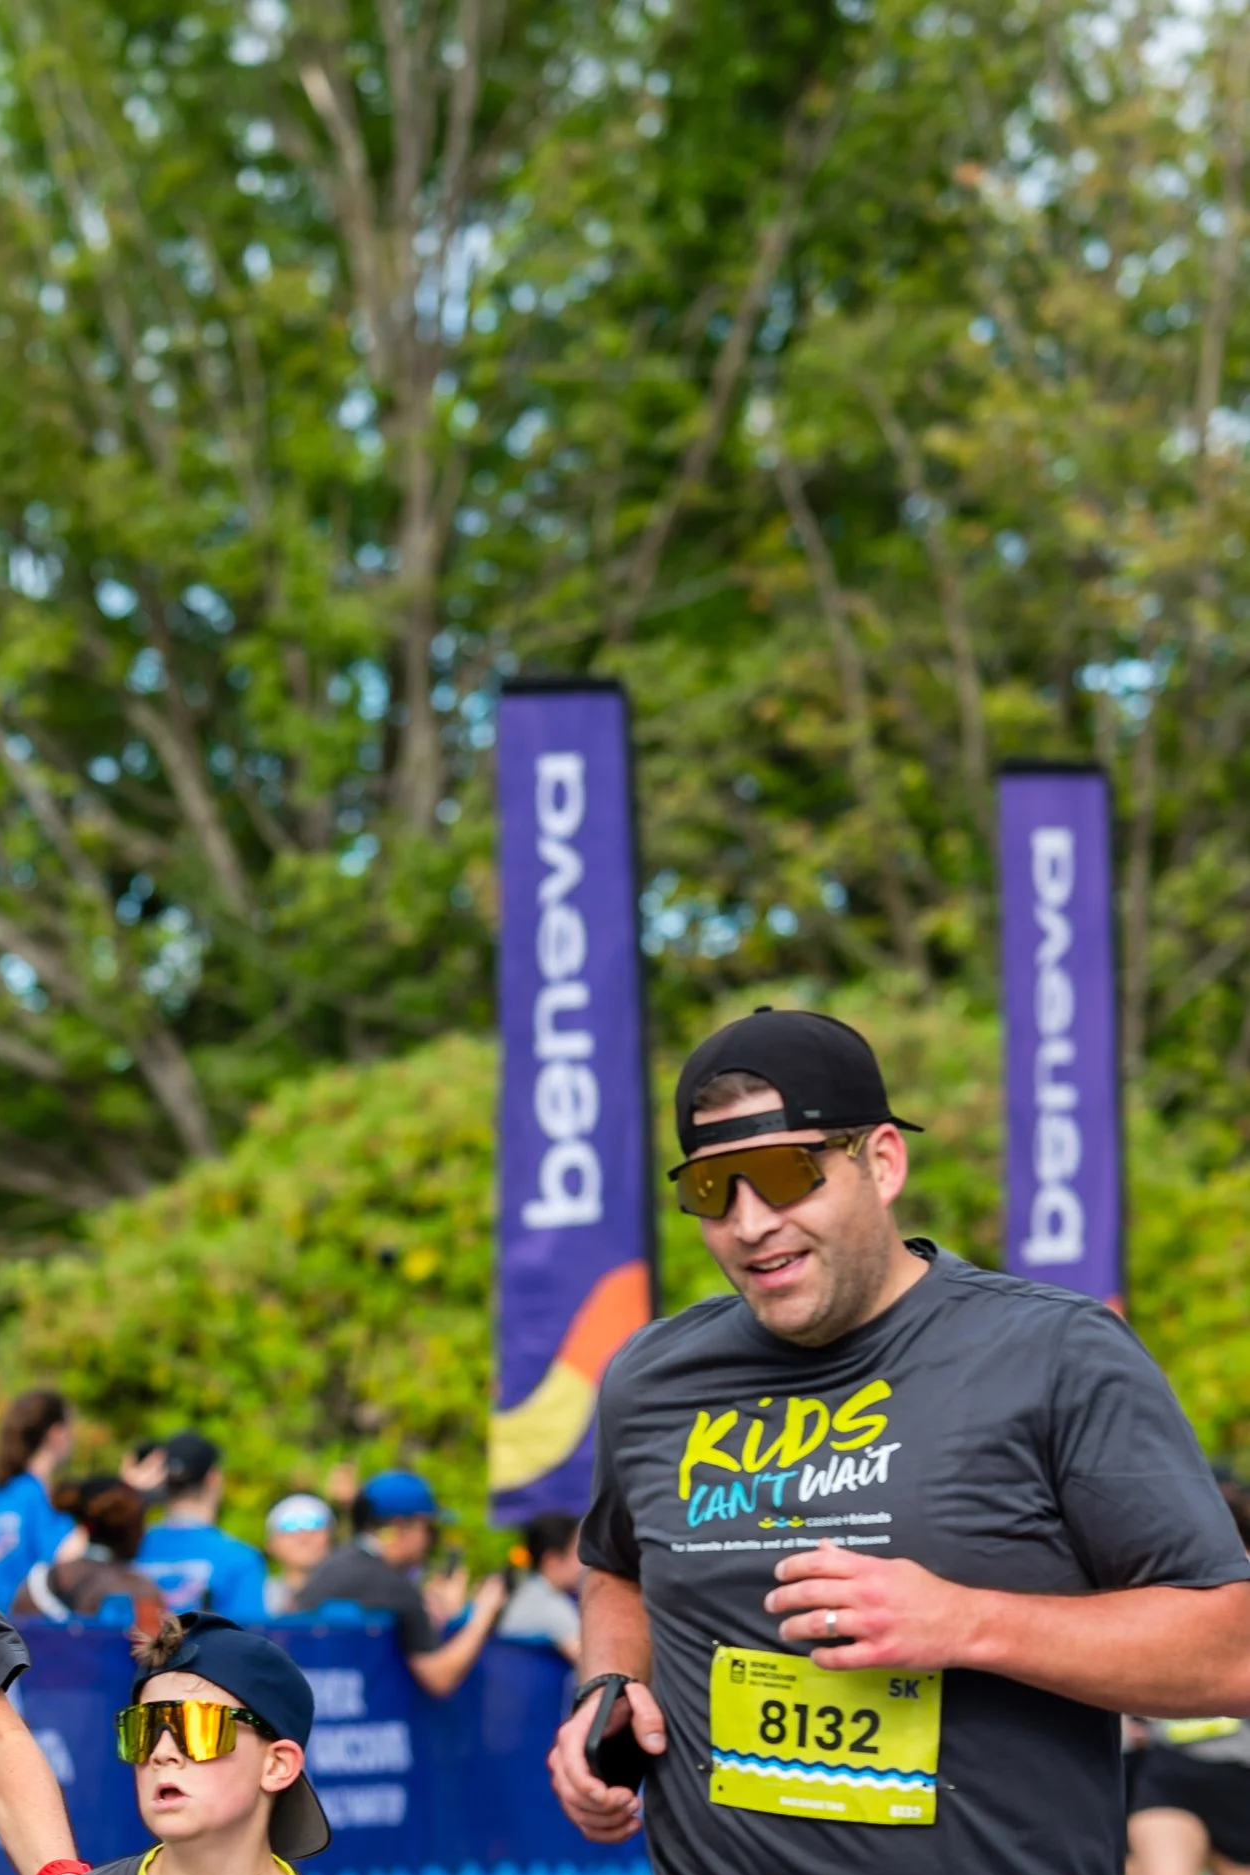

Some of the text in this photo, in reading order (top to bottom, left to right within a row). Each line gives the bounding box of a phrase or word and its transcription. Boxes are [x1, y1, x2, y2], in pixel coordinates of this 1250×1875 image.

[521, 751, 603, 1230] beneva
[1021, 826, 1086, 1266] beneva
[686, 1470, 799, 1528] CAN'T
[887, 1677, 921, 1699] 5K
[759, 1699, 881, 1755] 8132
